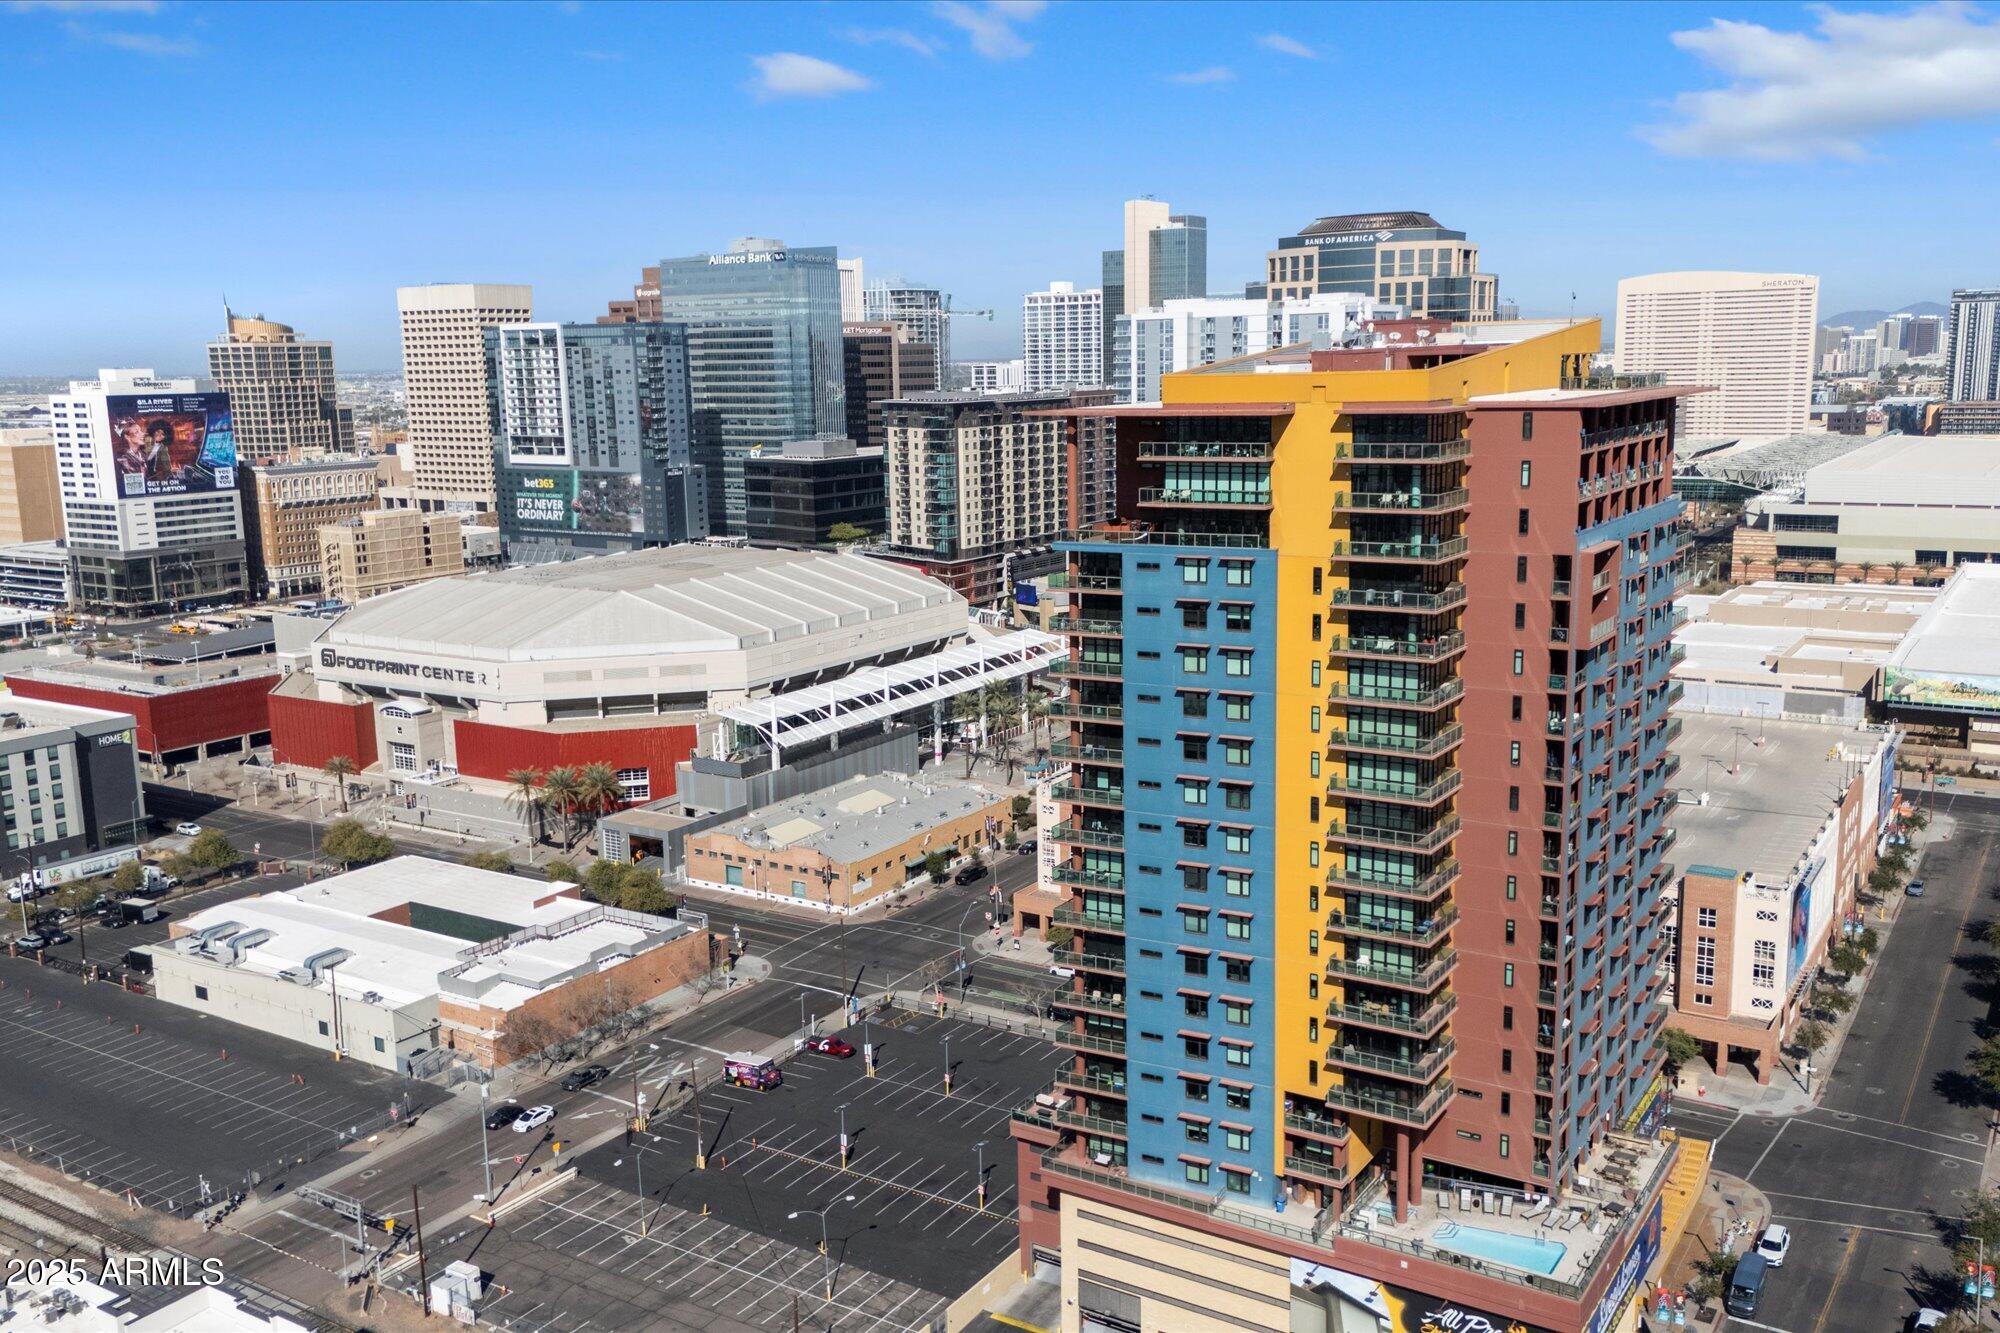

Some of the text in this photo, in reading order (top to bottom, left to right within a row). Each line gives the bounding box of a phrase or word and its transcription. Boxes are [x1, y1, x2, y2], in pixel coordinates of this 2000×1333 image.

[1305, 234, 1374, 246] BANK OF AMERICA
[709, 254, 746, 265] Alliance
[748, 252, 772, 263] Bank
[1762, 280, 1804, 288] SHERATON
[750, 449, 761, 459] EY
[524, 477, 555, 489] bet365
[517, 498, 564, 511] IT'S NEVER
[517, 508, 565, 521] ORDINARY
[337, 655, 487, 686] FOOTPRINT CENTER
[1421, 1309, 1464, 1330] All
